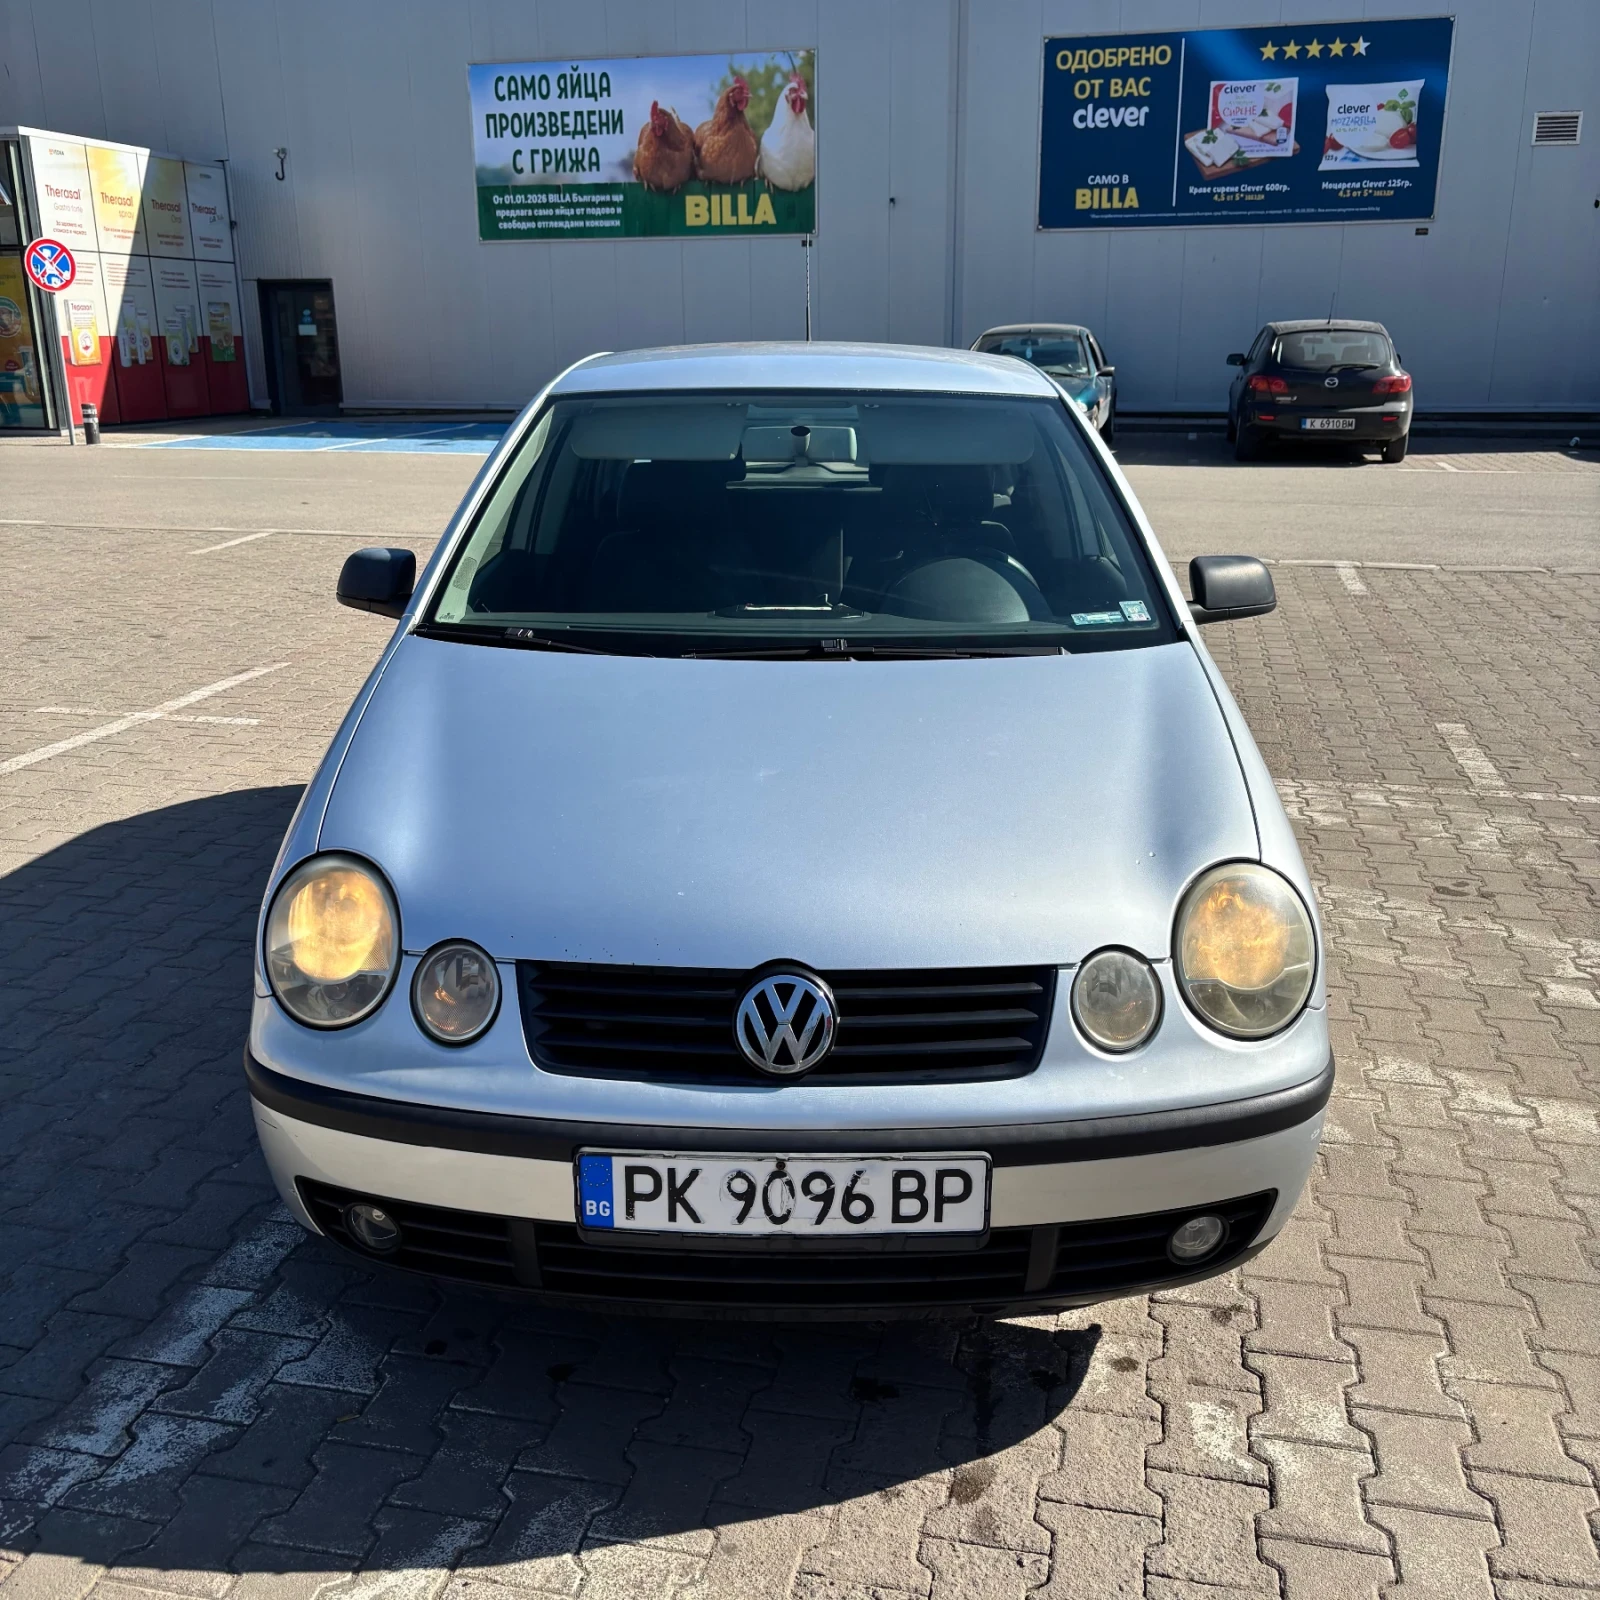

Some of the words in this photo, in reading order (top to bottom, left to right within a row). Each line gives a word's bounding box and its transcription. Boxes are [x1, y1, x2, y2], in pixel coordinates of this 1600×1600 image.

[1056, 45, 1172, 74] ОДОБРЕНО
[494, 73, 551, 102] САМО
[557, 65, 611, 102] ЯЙЦА
[1073, 79, 1104, 99] ОТ
[1110, 77, 1151, 98] ВАС
[1224, 84, 1256, 94] clever
[1073, 103, 1149, 129] clever
[1337, 104, 1370, 114] clever
[486, 109, 623, 140] ПРОИЗВЕДЕНИ
[512, 149, 524, 174] С
[530, 147, 600, 173] ГРИЖА
[1088, 175, 1119, 185] САМО
[1122, 174, 1129, 184] В
[1321, 181, 1360, 190] Моцарела
[1362, 179, 1386, 188] Clever
[1388, 179, 1412, 189] 125гр.
[45, 184, 81, 200] Therasal
[1189, 185, 1211, 195] Краве
[1212, 186, 1239, 194] сирене
[1240, 184, 1264, 192] Clever
[1265, 183, 1290, 192] 600гр.
[100, 192, 134, 207] Therasal
[151, 198, 182, 212] Therasal
[493, 194, 503, 204] От
[504, 193, 547, 204] 01.01.2026
[548, 193, 571, 203] BILLA
[572, 193, 610, 204] България
[611, 194, 624, 203] ще
[1075, 187, 1139, 210] BILLA
[192, 203, 217, 215] Therasal
[496, 208, 532, 219] предлага
[533, 208, 553, 216] само
[554, 206, 574, 217] яйца
[575, 207, 585, 215] от
[586, 207, 615, 216] подово
[685, 193, 777, 227] BILLA
[498, 220, 536, 230] свободно
[537, 219, 585, 229] отглеждани
[586, 219, 621, 227] кокошки
[1310, 419, 1316, 428] K
[1320, 419, 1340, 429] 6910
[1342, 419, 1354, 428] BM
[624, 1165, 705, 1223] PK
[725, 1169, 875, 1225] 9096
[891, 1168, 973, 1223] BP
[586, 1200, 611, 1215] BG
